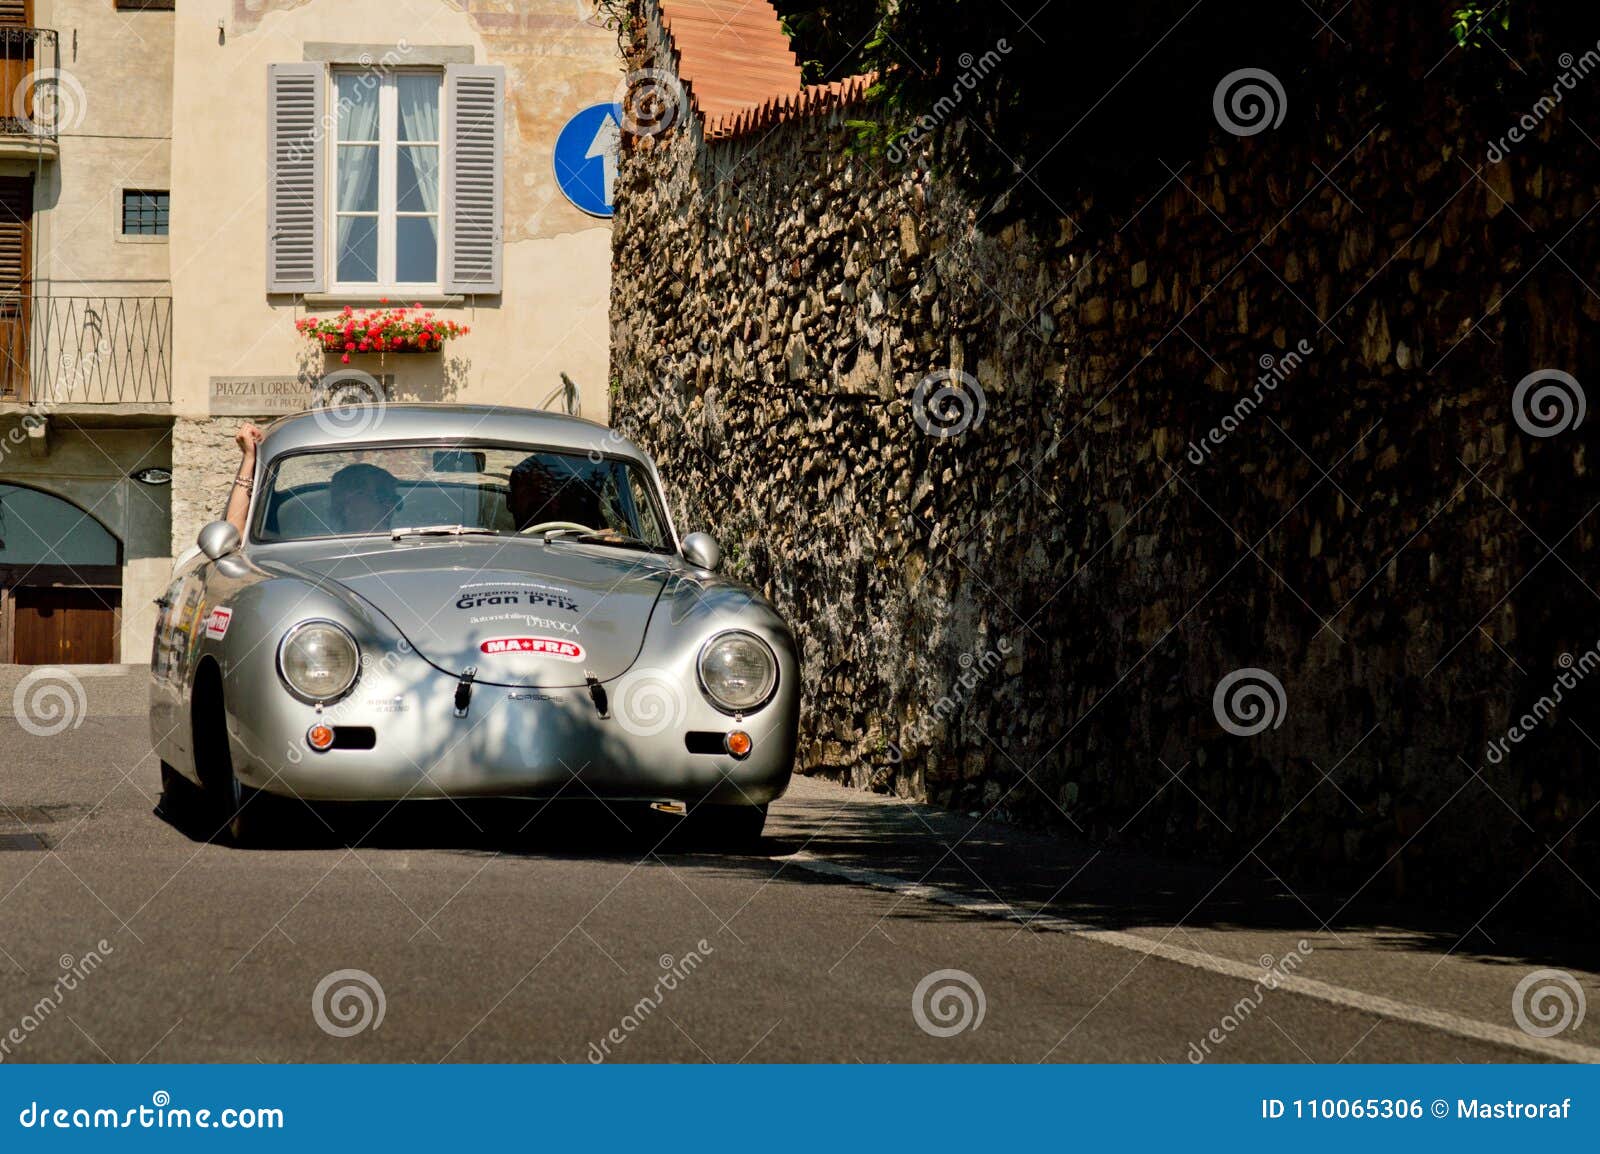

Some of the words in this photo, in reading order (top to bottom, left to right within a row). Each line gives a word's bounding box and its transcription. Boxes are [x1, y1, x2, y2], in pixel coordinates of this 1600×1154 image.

[215, 382, 257, 396] PIAZZA
[260, 382, 313, 396] LORENZO
[456, 595, 519, 609] Gran
[529, 595, 579, 613] Prix
